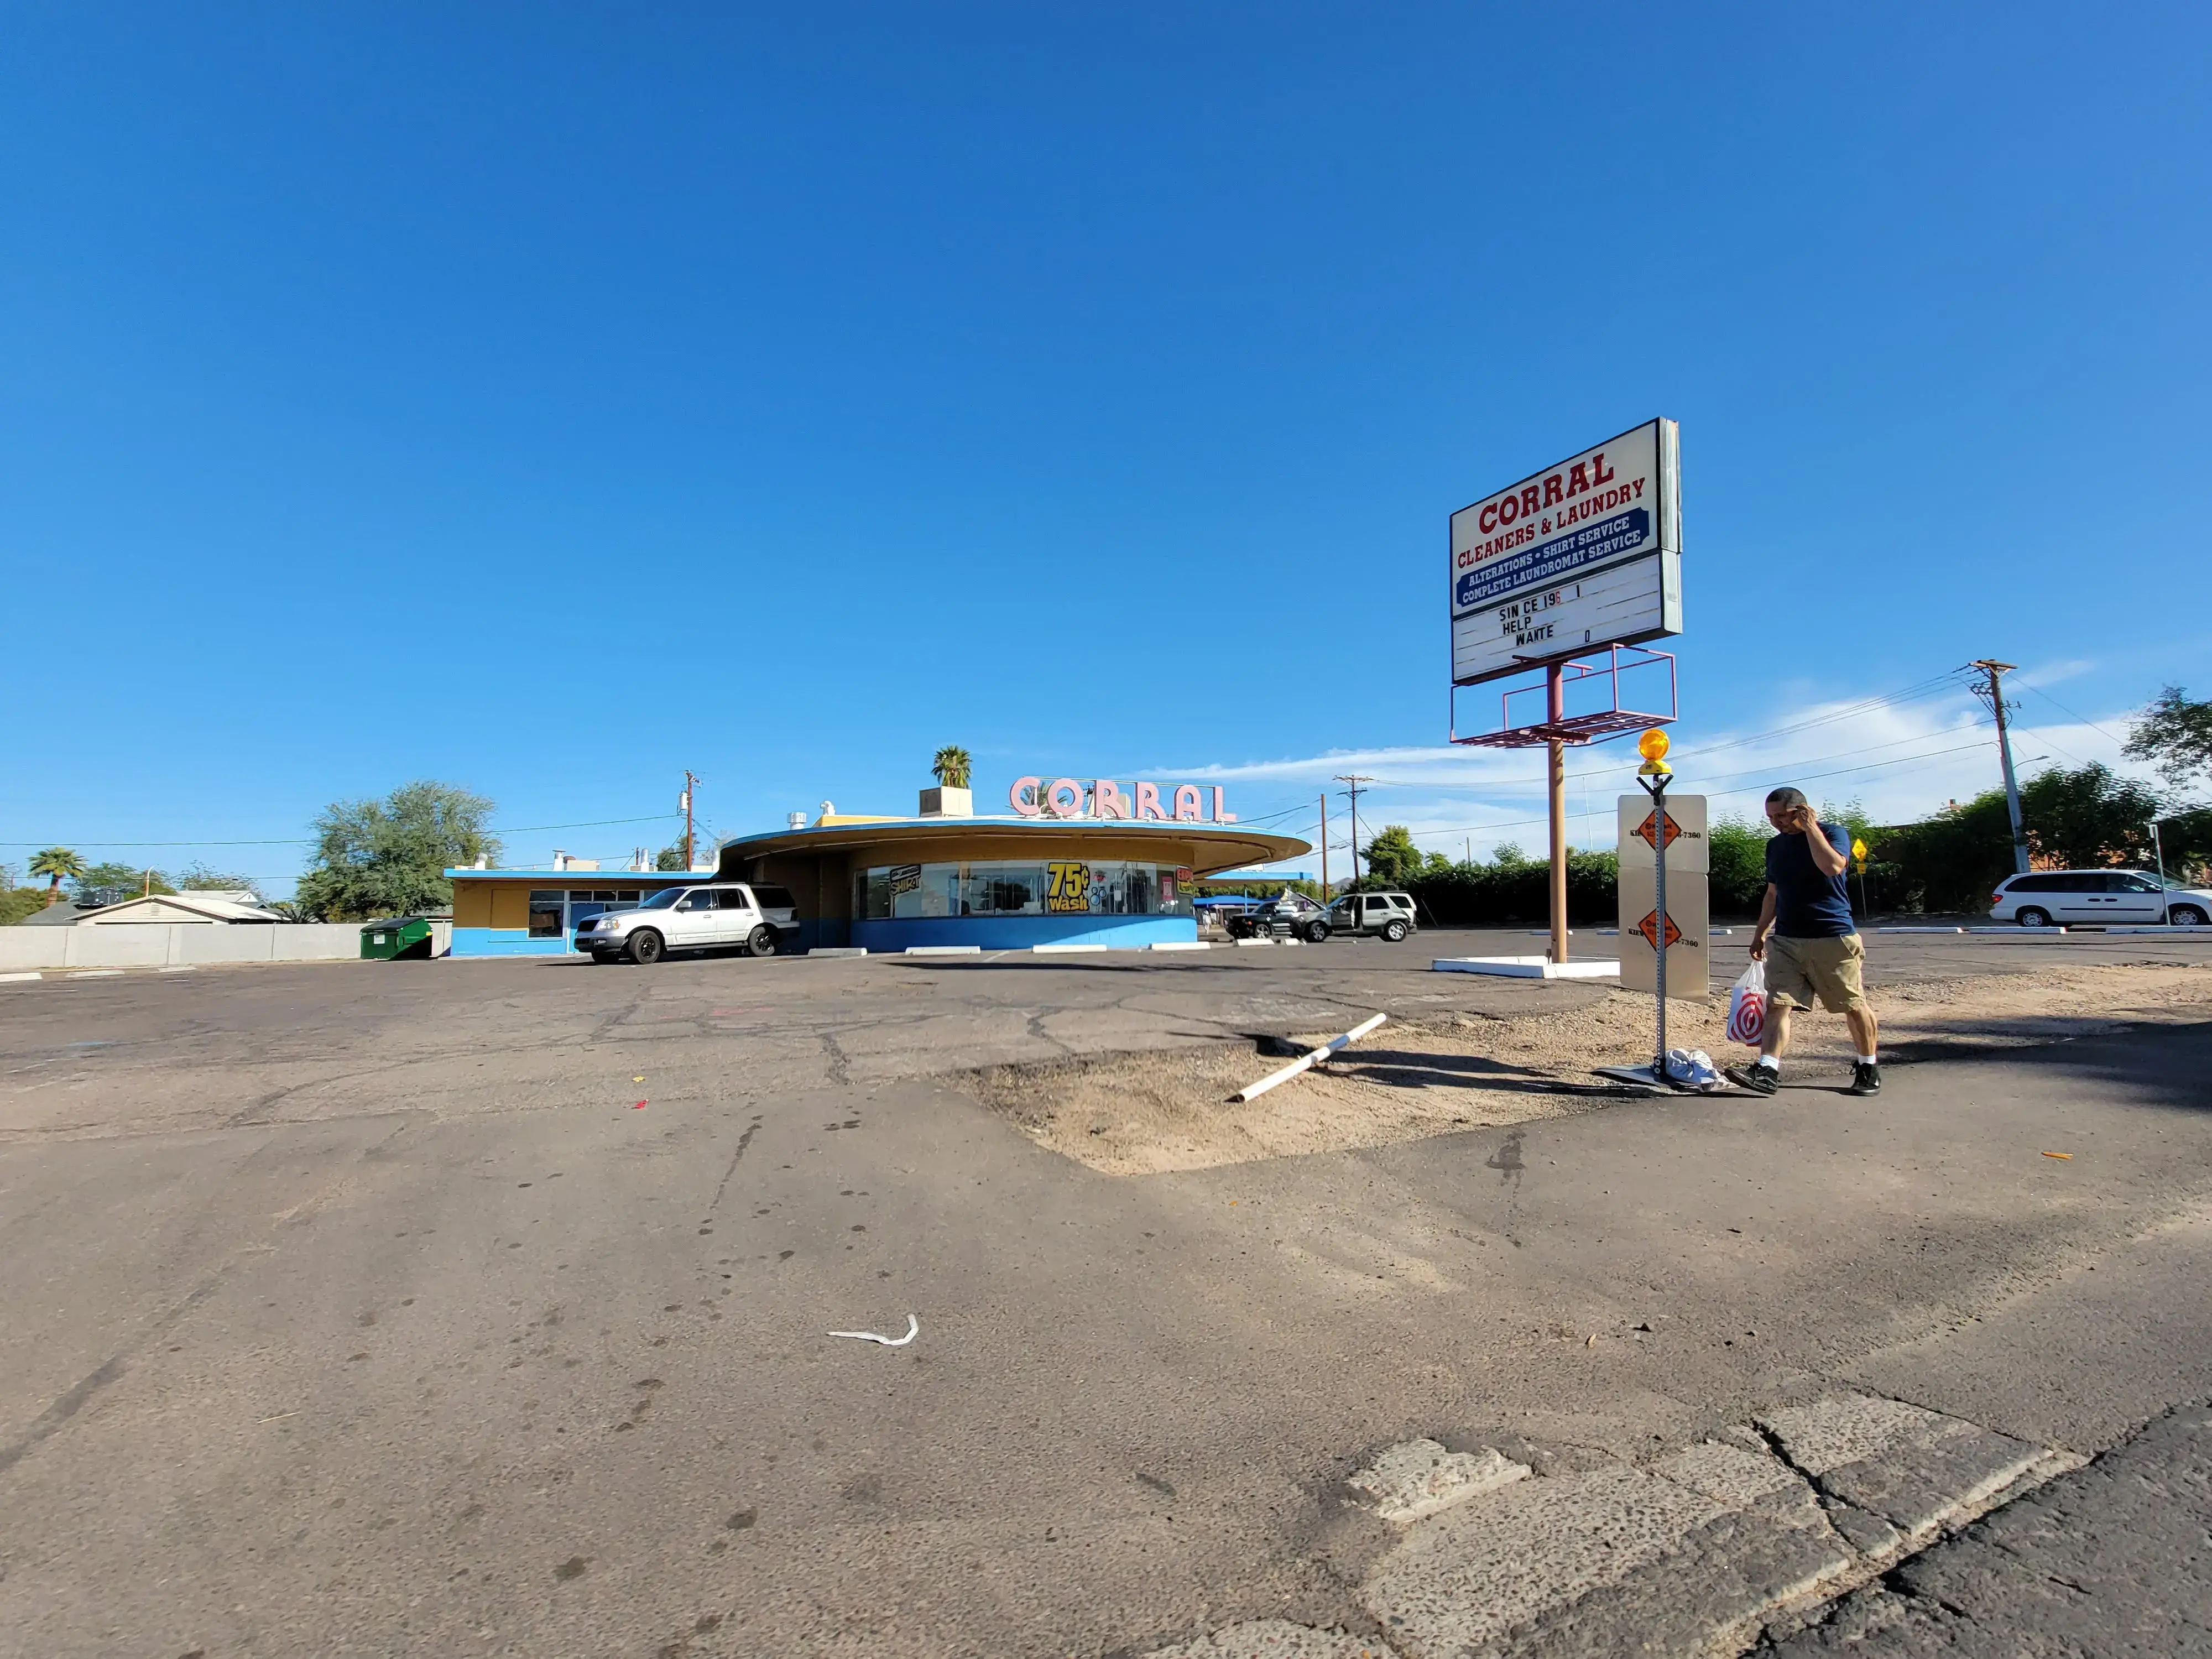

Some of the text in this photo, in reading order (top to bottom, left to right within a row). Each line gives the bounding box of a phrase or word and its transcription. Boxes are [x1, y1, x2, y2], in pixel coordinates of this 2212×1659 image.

[1458, 477, 1645, 568] CLEANERS & LAUNDRY
[1479, 453, 1614, 534] CORRAL
[1462, 529, 1641, 603] COMPLETE LAUNDROMAT SERVICE
[1469, 516, 1630, 587] ALTERATIONS SHIRT SERVICE
[1503, 616, 1531, 635] HELP
[1516, 625, 1553, 646] WANTE
[1009, 776, 1237, 822] CORRAL
